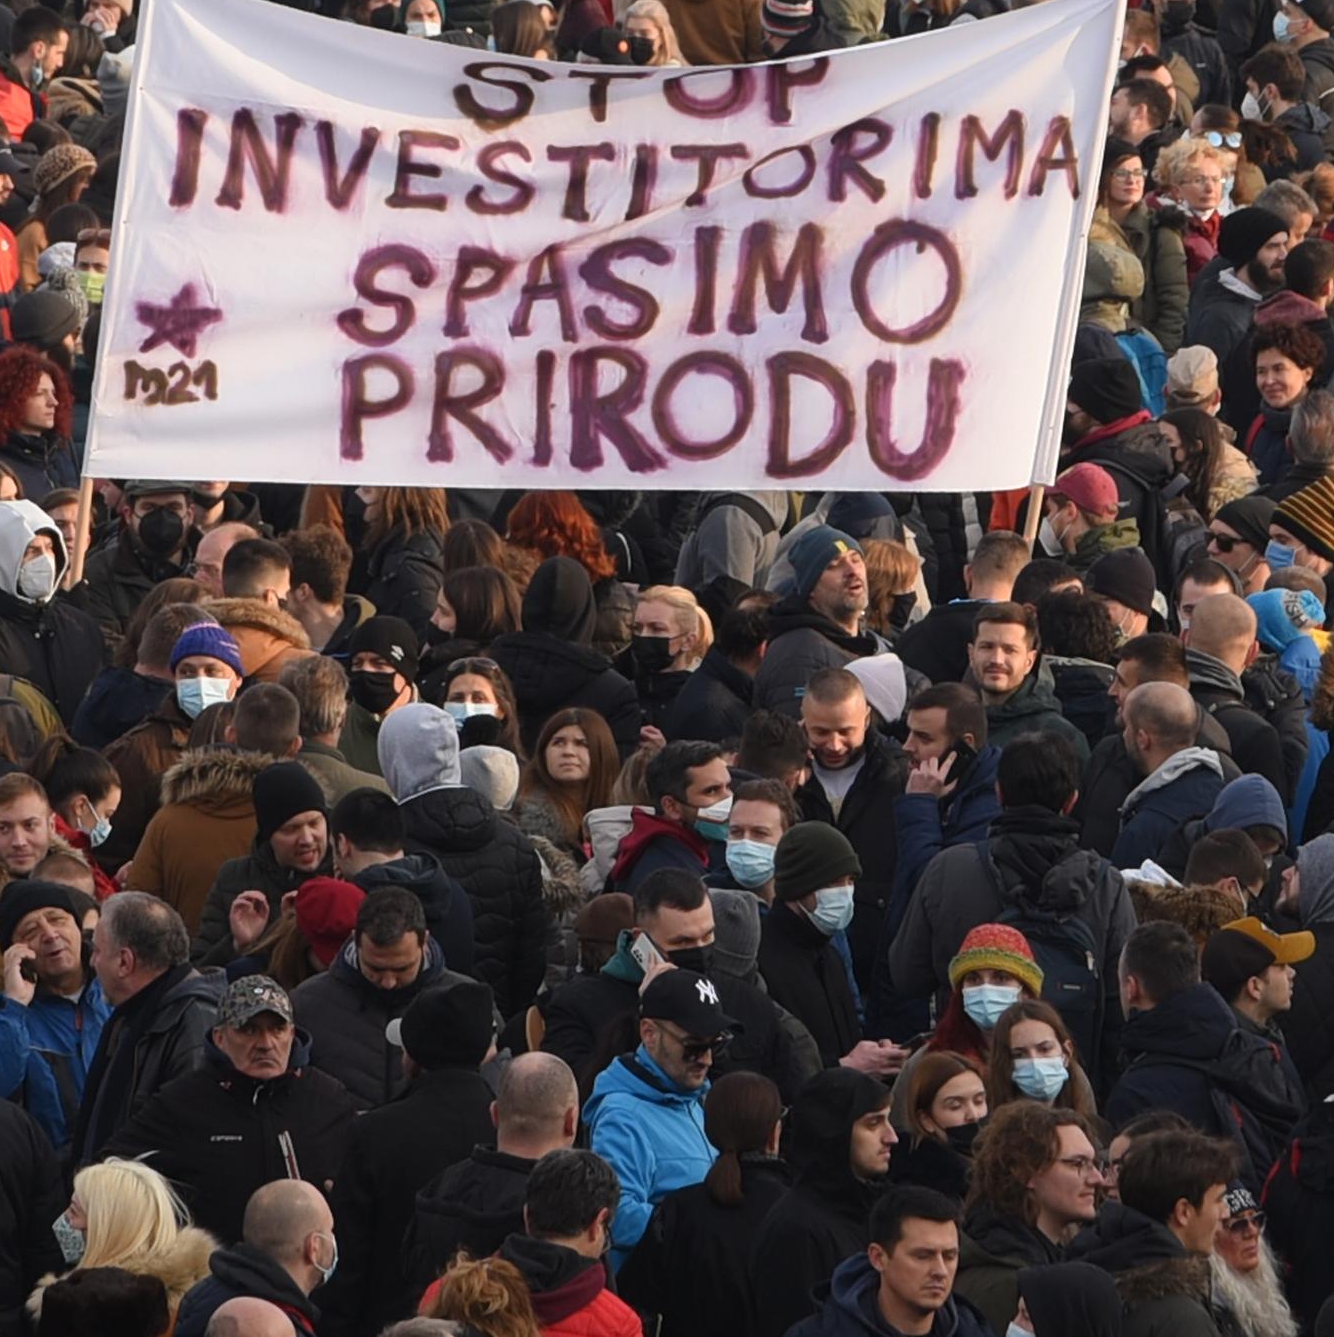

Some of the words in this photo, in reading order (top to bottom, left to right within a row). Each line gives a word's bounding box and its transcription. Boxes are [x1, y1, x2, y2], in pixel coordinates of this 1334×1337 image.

[452, 56, 829, 131] STOP
[167, 106, 1083, 223] INVESTITORIMA
[334, 216, 966, 349] SPASIMO
[337, 343, 967, 483] PRIRODU
